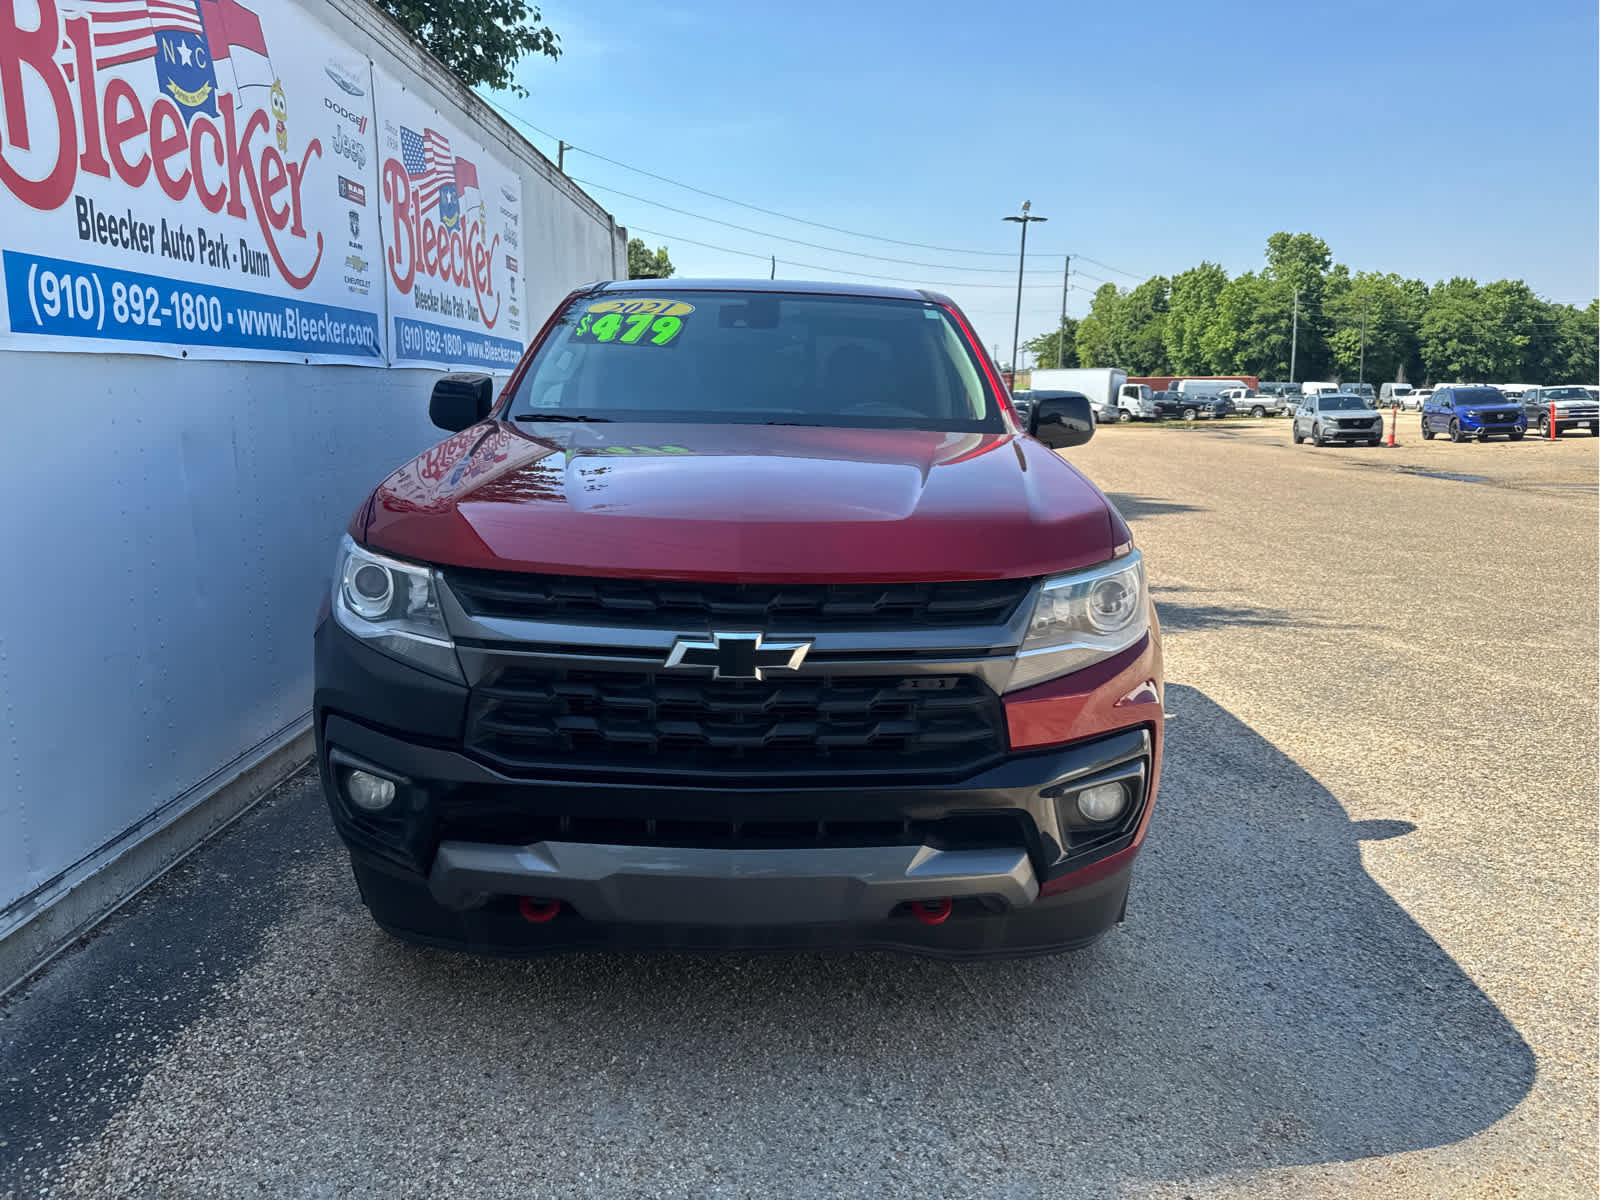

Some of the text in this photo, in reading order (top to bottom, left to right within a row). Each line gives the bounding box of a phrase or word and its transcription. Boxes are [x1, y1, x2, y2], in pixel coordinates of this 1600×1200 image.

[162, 37, 207, 69] N C
[324, 98, 361, 127] DODGE
[0, 0, 323, 290] Bleecker
[332, 124, 367, 170] Jeep
[348, 183, 364, 195] RAM
[75, 195, 271, 278] Bleecker Auto Park Dunn
[348, 240, 363, 250] RAM
[383, 158, 500, 329] Bleecker
[28, 264, 375, 347] (910) 892-1800 www.Bleecker.com
[414, 284, 440, 312] Bleecker
[440, 291, 453, 317] Auto
[452, 295, 465, 319] Park
[611, 302, 675, 314] 2021
[401, 322, 521, 363] (910) 892-1800 www.Bleecker.com
[576, 313, 682, 345] $479
